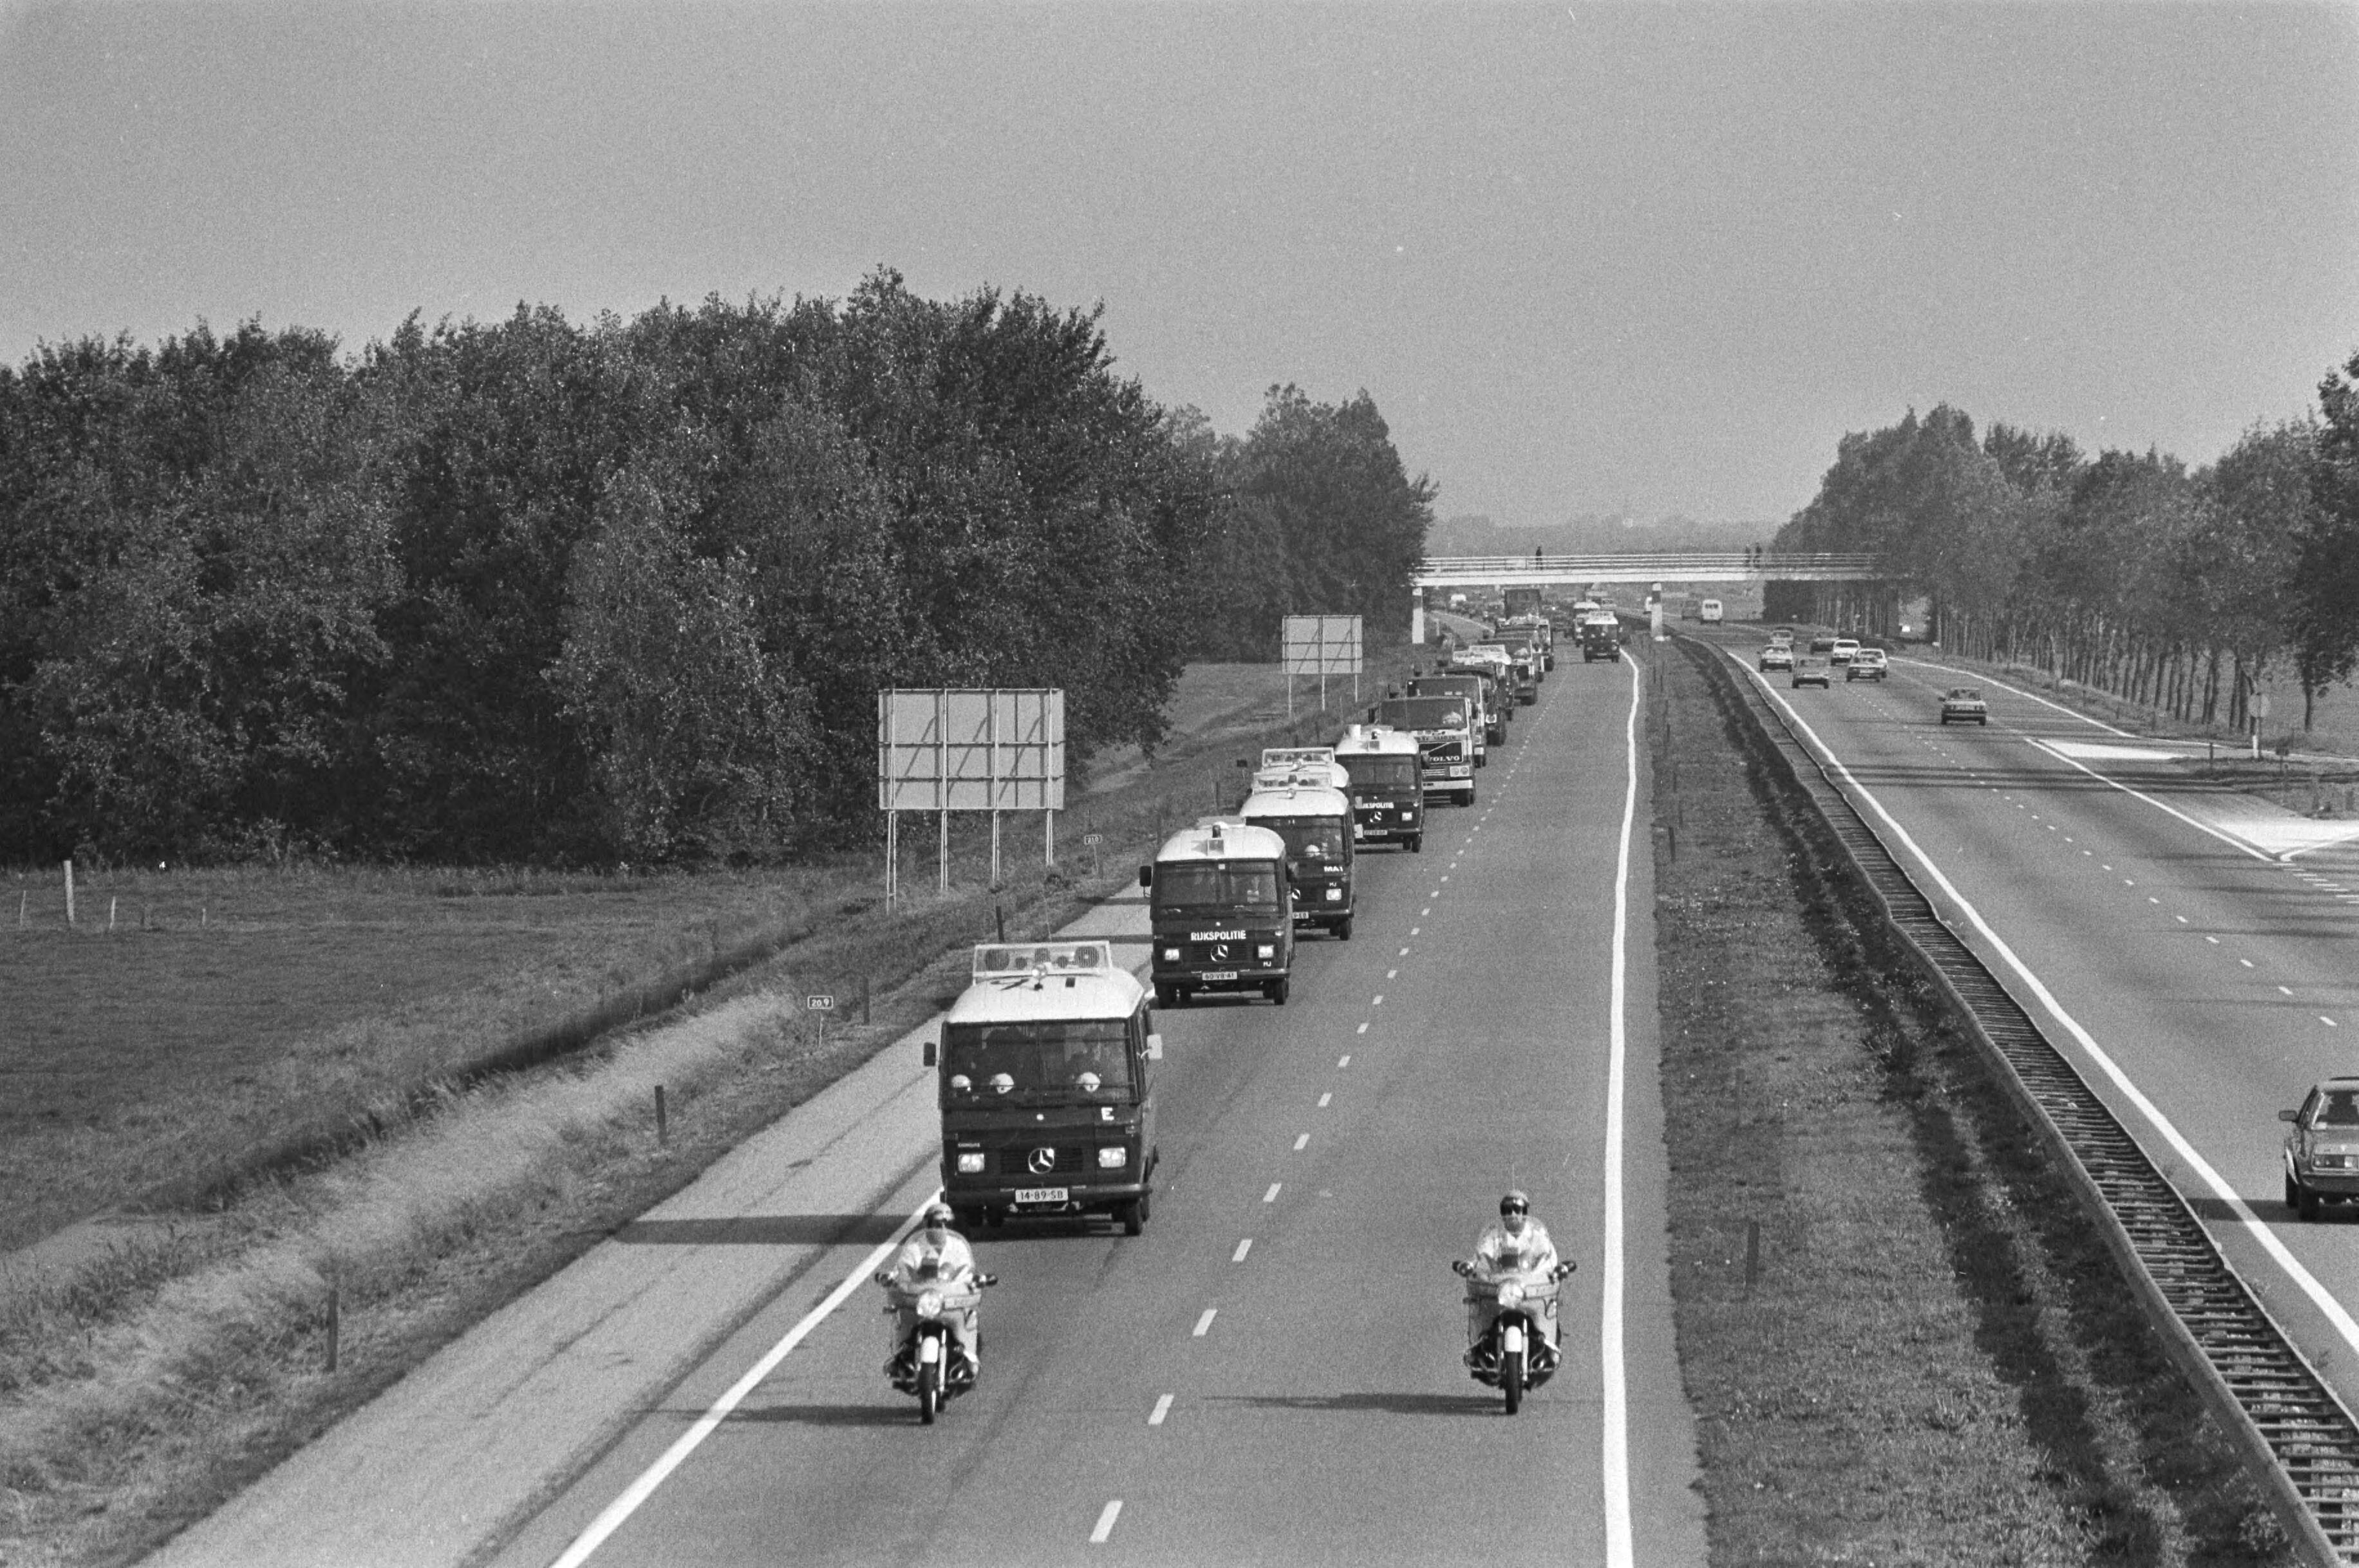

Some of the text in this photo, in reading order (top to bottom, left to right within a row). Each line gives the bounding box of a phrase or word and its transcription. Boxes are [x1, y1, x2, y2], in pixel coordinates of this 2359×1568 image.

[1190, 930, 1246, 941] RIJKSPOLITIE
[1101, 1106, 1114, 1121] E
[1020, 1190, 1064, 1200] 14-89-SB
